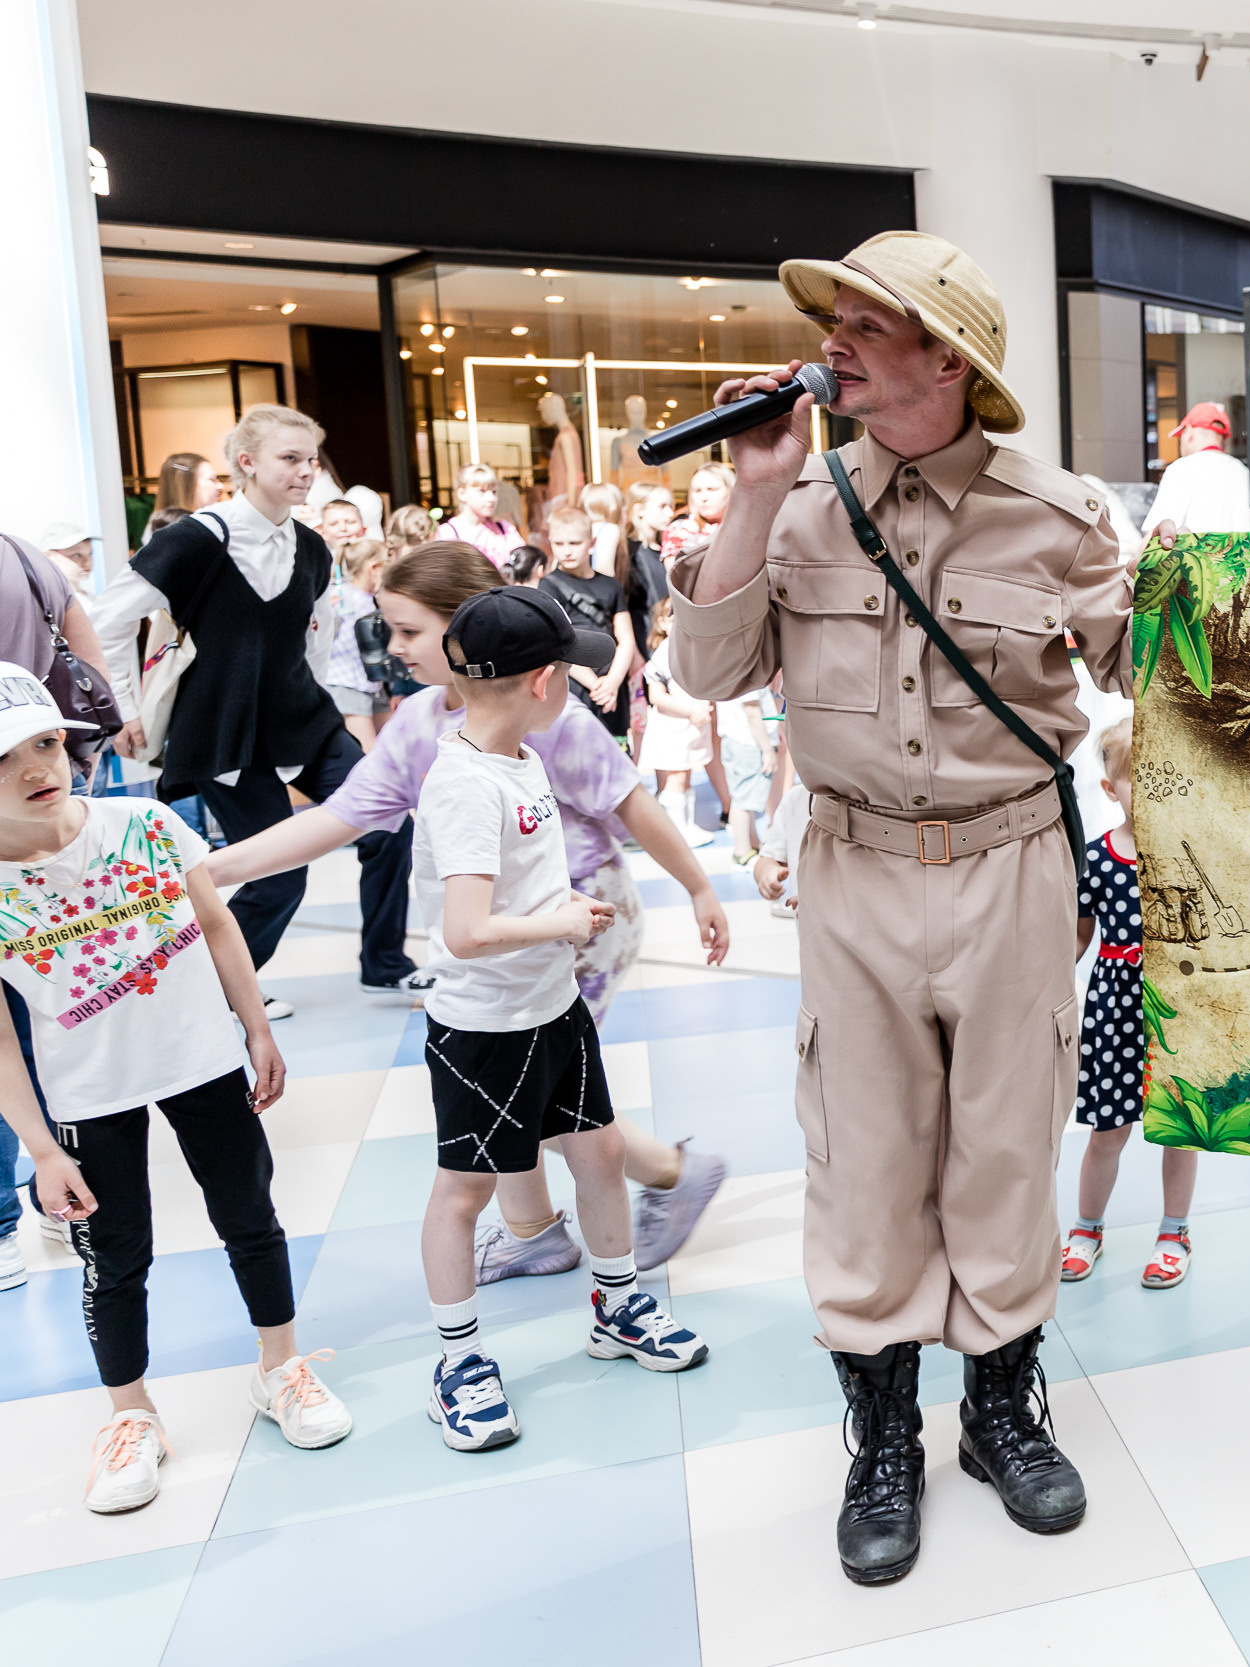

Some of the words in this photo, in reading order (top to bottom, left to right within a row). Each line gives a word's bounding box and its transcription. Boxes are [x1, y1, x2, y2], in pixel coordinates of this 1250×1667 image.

[102, 897, 161, 925] ORIGINAL
[4, 940, 35, 953] MISS
[38, 919, 100, 947] ORIGINAL
[140, 946, 170, 974] STY
[171, 923, 201, 950] CHIC
[69, 998, 103, 1023] CHIC
